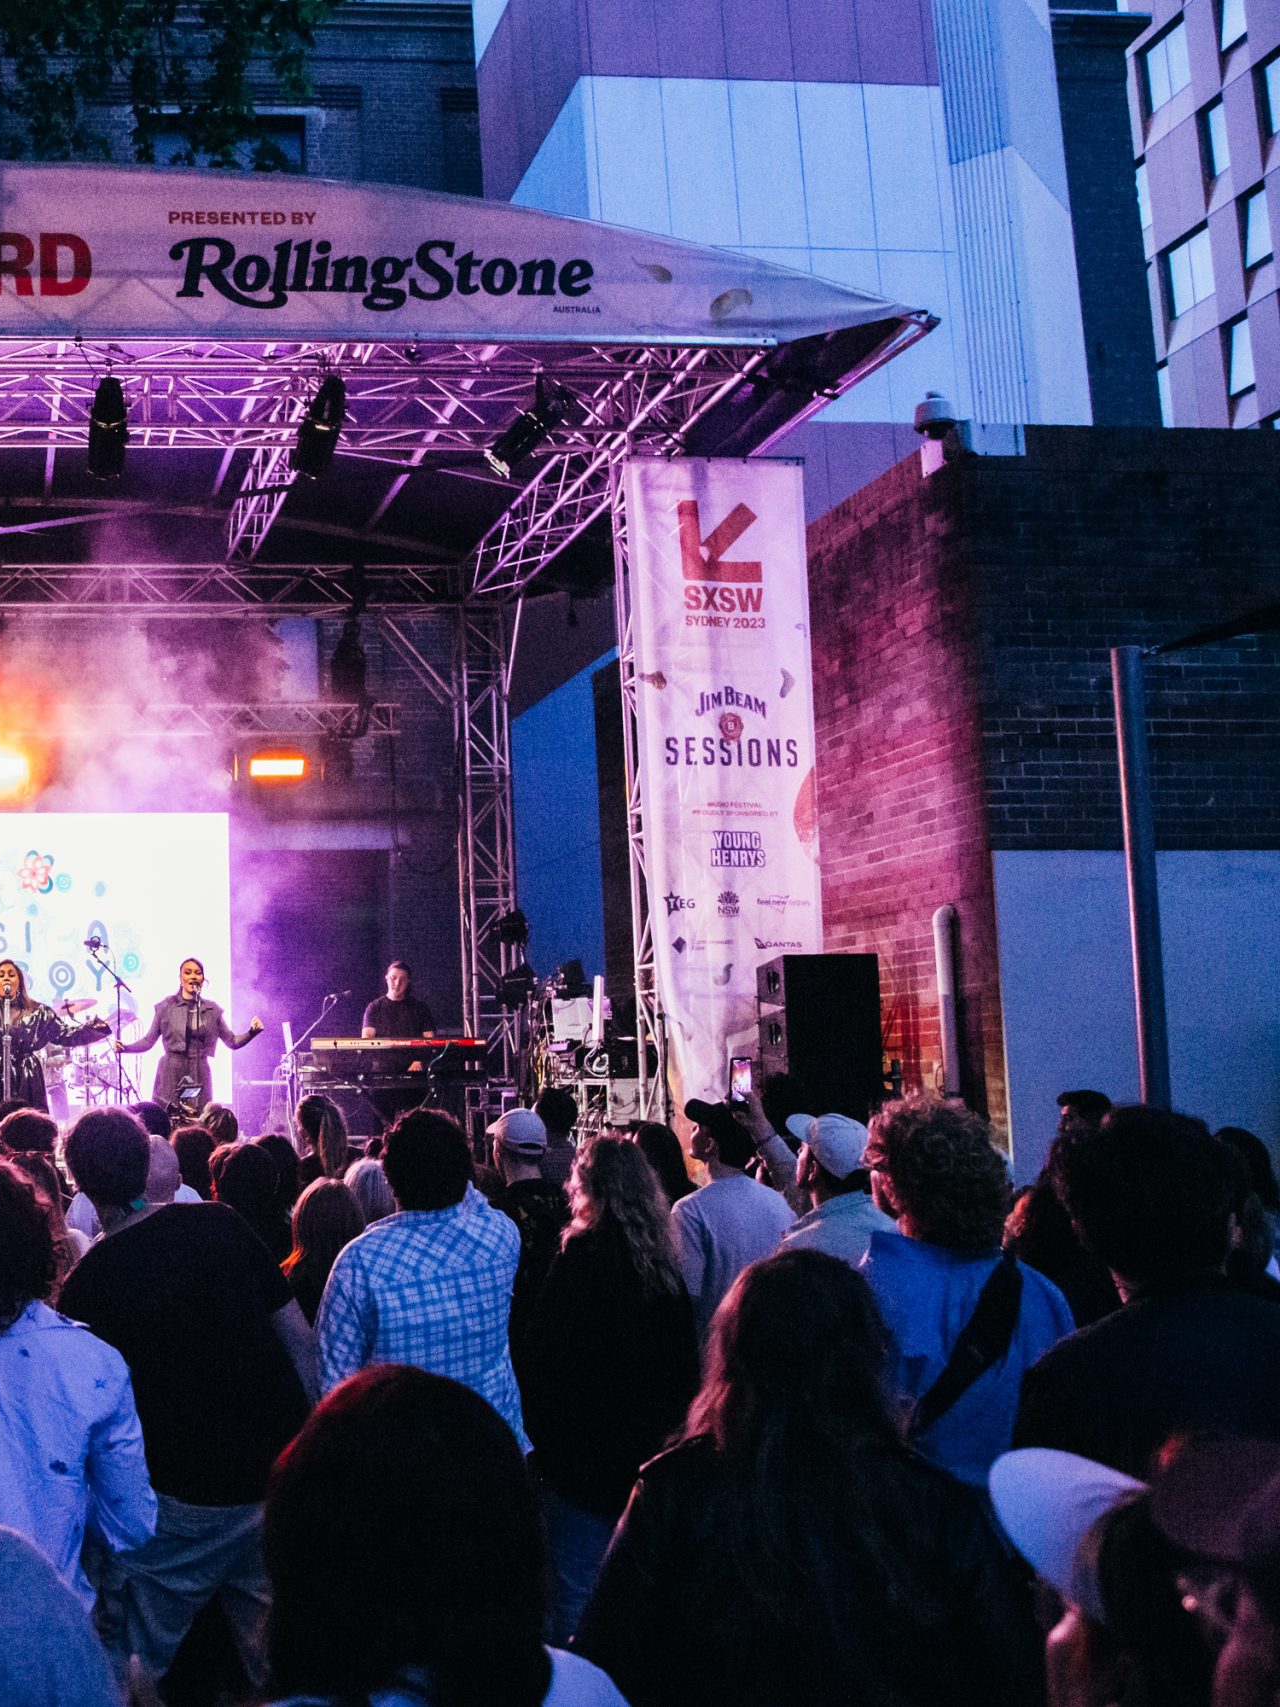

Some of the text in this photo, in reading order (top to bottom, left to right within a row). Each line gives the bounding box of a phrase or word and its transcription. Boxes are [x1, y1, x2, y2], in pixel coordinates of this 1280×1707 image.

[168, 211, 316, 225] PRESENTED BY
[553, 306, 601, 314] AUSTRALIA
[684, 585, 763, 613] SXSW
[685, 615, 766, 629] SYDNEY 2023
[695, 686, 767, 719] JIM BEAM
[665, 737, 798, 767] SESSIONS
[712, 831, 762, 850] YOUNG
[711, 848, 766, 868] HENRYS
[718, 906, 740, 914] NSW
